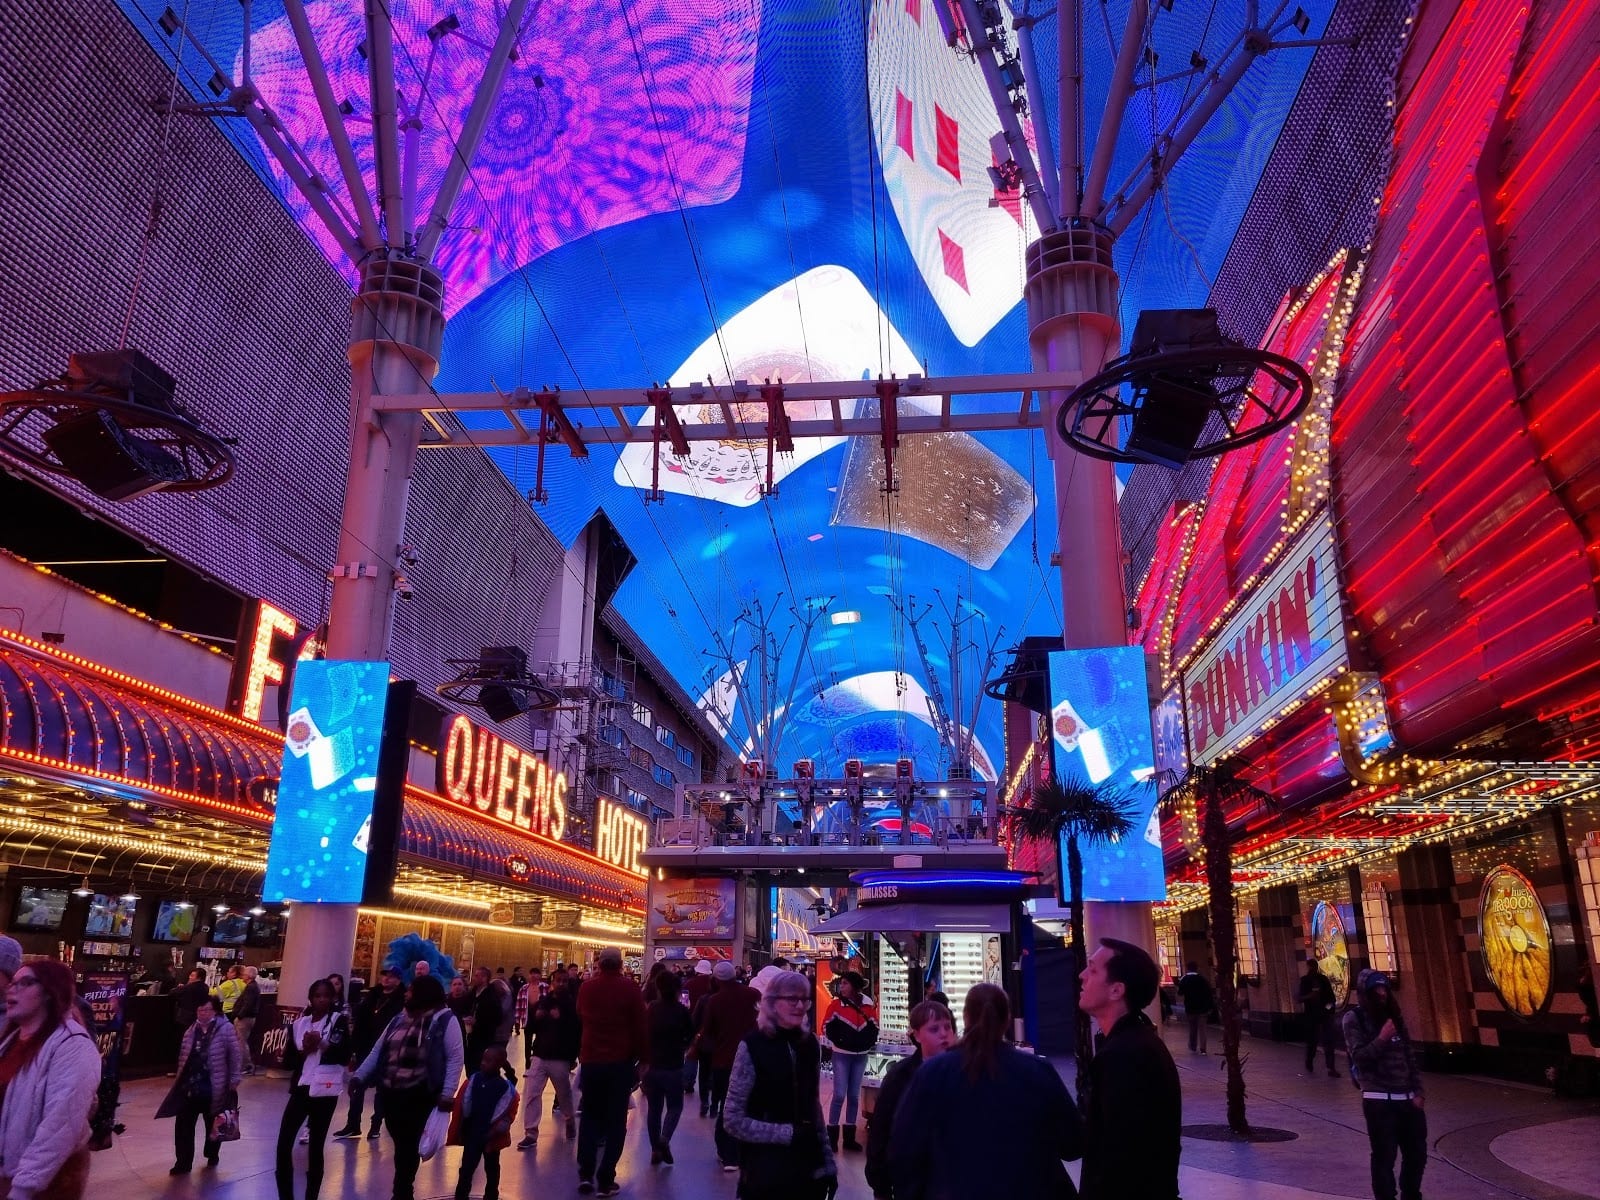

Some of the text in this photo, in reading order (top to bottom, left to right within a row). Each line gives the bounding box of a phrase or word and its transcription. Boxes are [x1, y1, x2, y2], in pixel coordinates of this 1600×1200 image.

[1189, 555, 1318, 754] DUNKIN'
[445, 714, 568, 842] QUEENS
[597, 799, 650, 877] HOTEL
[84, 990, 108, 1001] PATIO
[91, 1002, 114, 1011] EXIT
[94, 1012, 116, 1021] NLY
[260, 1027, 288, 1055] PATIO
